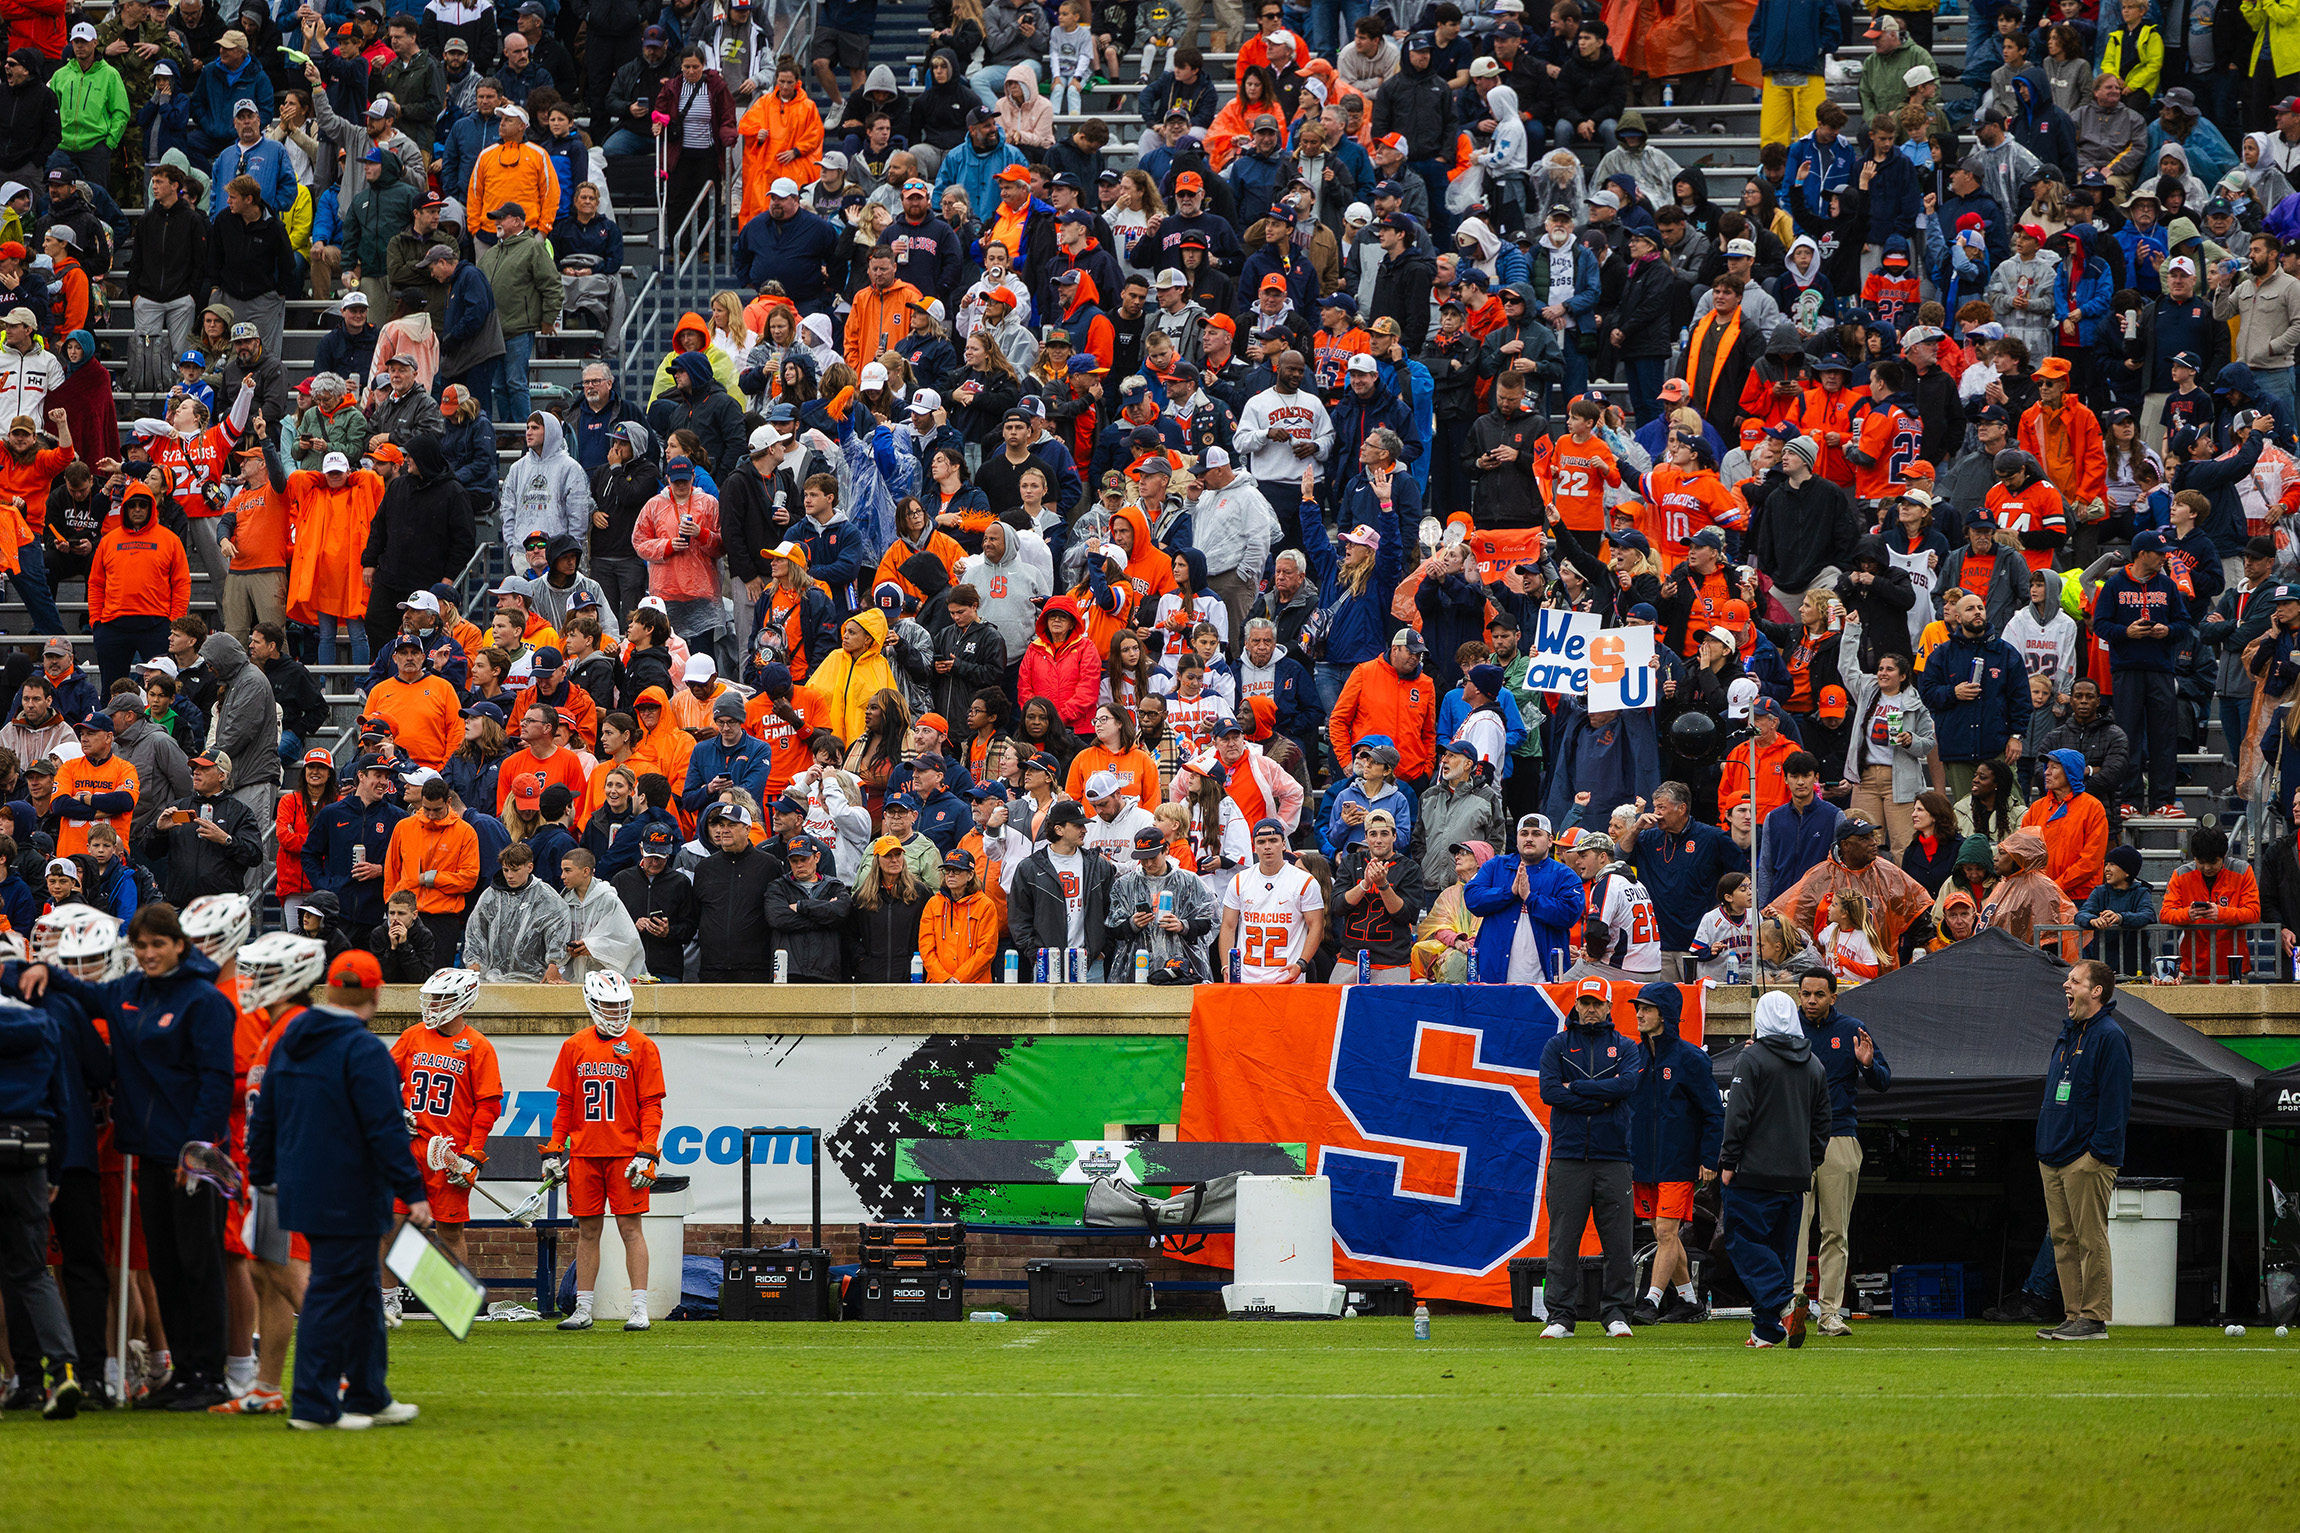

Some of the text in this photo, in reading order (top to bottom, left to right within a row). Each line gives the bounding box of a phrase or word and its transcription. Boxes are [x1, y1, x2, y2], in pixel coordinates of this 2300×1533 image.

[893, 315, 901, 325] S
[187, 351, 196, 361] D
[910, 351, 923, 363] S
[27, 376, 43, 387] HH
[1268, 406, 1315, 426] SYRACUSE
[1515, 433, 1522, 442] S
[1110, 478, 1117, 487] S
[1555, 470, 1588, 497] 22
[1662, 493, 1701, 511] SYRACUSE
[1665, 511, 1691, 543] 10
[1483, 542, 1497, 555] S
[1906, 560, 1913, 568] S
[2118, 591, 2170, 605] SYRACUSE
[1703, 598, 1714, 612] S
[1537, 608, 1586, 661] We
[2025, 639, 2057, 651] ORANGE
[1526, 664, 1589, 694] are
[1410, 688, 1419, 703] S
[1828, 695, 1835, 705] S
[779, 737, 789, 750] S
[1109, 763, 1117, 773] S
[75, 779, 114, 793] SYRACUSE
[125, 778, 135, 791] S
[526, 787, 534, 796] S
[376, 822, 385, 835] S
[1685, 840, 1695, 853] S
[2219, 896, 2227, 907] S
[1244, 911, 1293, 924] SYRACUSE
[1243, 926, 1289, 968] 22
[1831, 1037, 1840, 1049] S
[1607, 1046, 1617, 1058] S
[412, 1057, 467, 1082] SYRACUSE
[577, 1063, 629, 1080] SYRACUSE
[1663, 1067, 1671, 1080] S
[410, 1075, 456, 1118] 33
[582, 1079, 616, 1122] 21
[1316, 985, 1566, 1277] S
[1640, 1199, 1651, 1213] S
[755, 1275, 787, 1284] RIDGID
[893, 1289, 926, 1297] RIDGID
